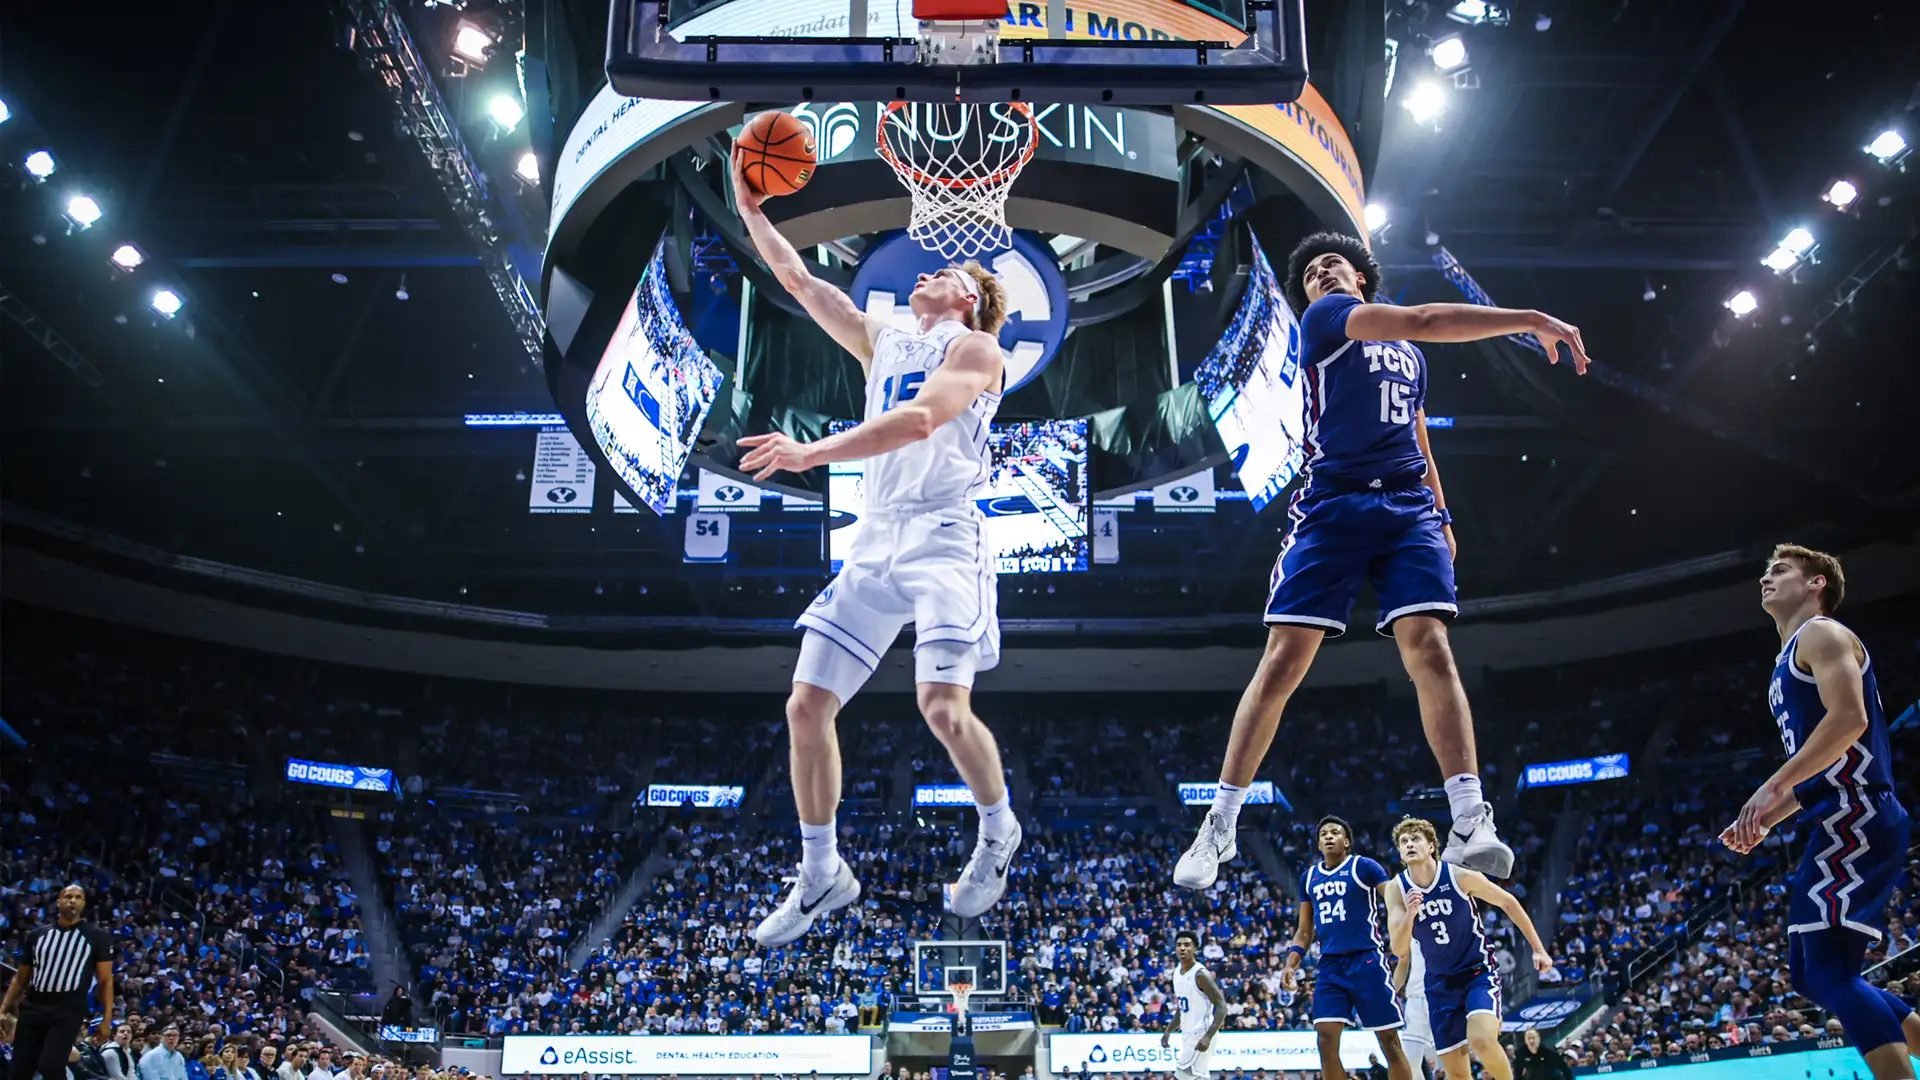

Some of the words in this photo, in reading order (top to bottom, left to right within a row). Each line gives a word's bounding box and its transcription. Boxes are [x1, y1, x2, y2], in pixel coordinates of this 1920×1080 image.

[987, 101, 1126, 155] SKIN
[574, 121, 609, 164] DENTAL
[1363, 345, 1416, 382] TCU
[1379, 380, 1412, 426] 15
[695, 520, 719, 536] 54
[288, 763, 307, 779] GO
[307, 766, 355, 785] COUGS
[1528, 768, 1547, 783] GO
[1547, 763, 1593, 782] COUGS
[650, 789, 667, 802] GO
[668, 790, 710, 803] COUGS
[916, 789, 934, 803] GO
[1181, 788, 1198, 801] GO
[1313, 881, 1347, 901] TCU
[1319, 899, 1347, 925] 24
[1417, 899, 1453, 922] TCU
[1430, 920, 1450, 945] 3
[563, 1047, 634, 1065] eAssist
[656, 1052, 690, 1060] DENTAL
[692, 1052, 726, 1060] HEALTH
[728, 1052, 780, 1060] EDUCATION
[1112, 1045, 1181, 1062] eAssist
[1276, 1048, 1319, 1056] EDUCATIO
